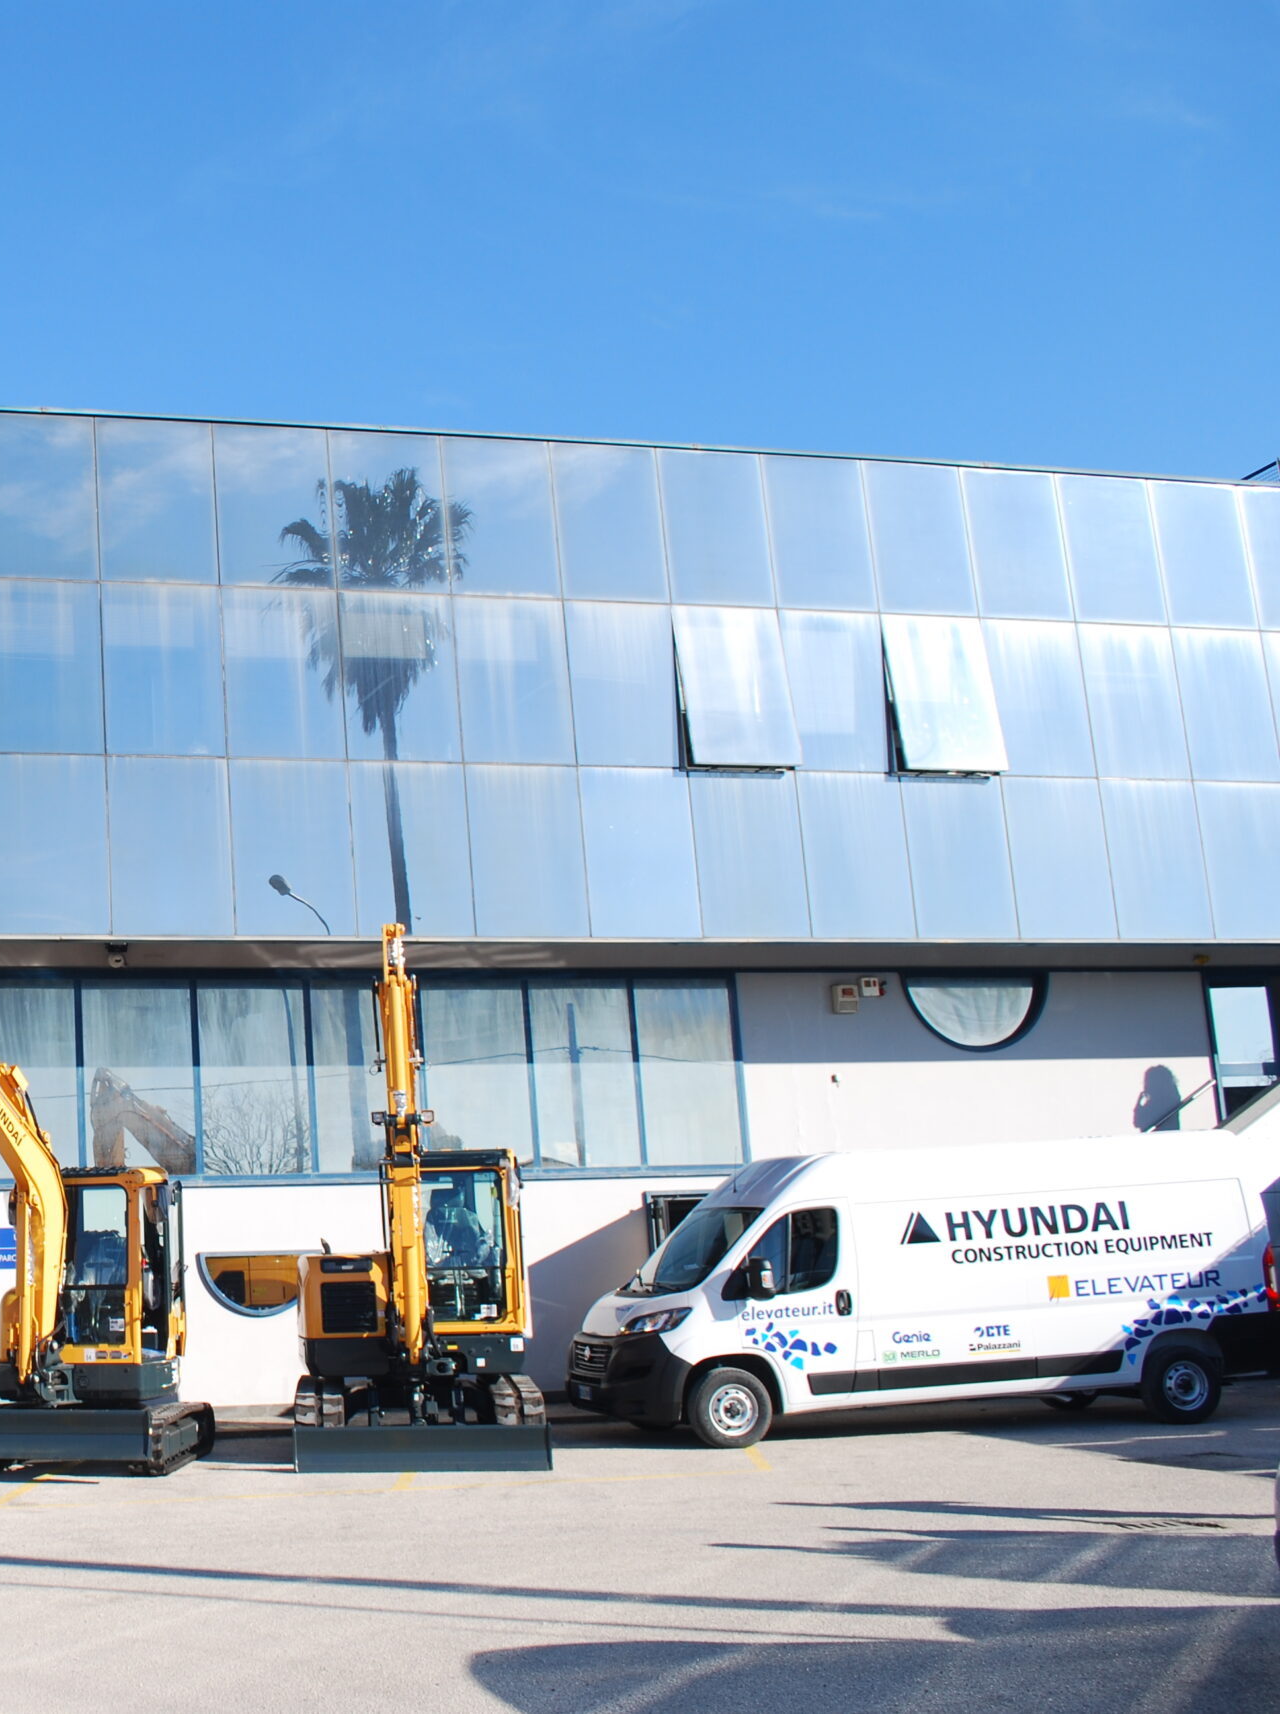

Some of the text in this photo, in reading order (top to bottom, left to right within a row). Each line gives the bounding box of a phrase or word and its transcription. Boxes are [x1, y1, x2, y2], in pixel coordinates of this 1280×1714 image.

[945, 1201, 1131, 1242] HYUNDAI
[951, 1232, 1214, 1264] CONSTRUCTION EQUIPMENT
[1075, 1269, 1222, 1297] ELEVATEUR
[741, 1302, 834, 1321] elevateur.it
[892, 1330, 932, 1344] Genie
[985, 1324, 1011, 1337] CTE
[977, 1340, 1021, 1351] Palazzani
[900, 1349, 940, 1359] MERLO
